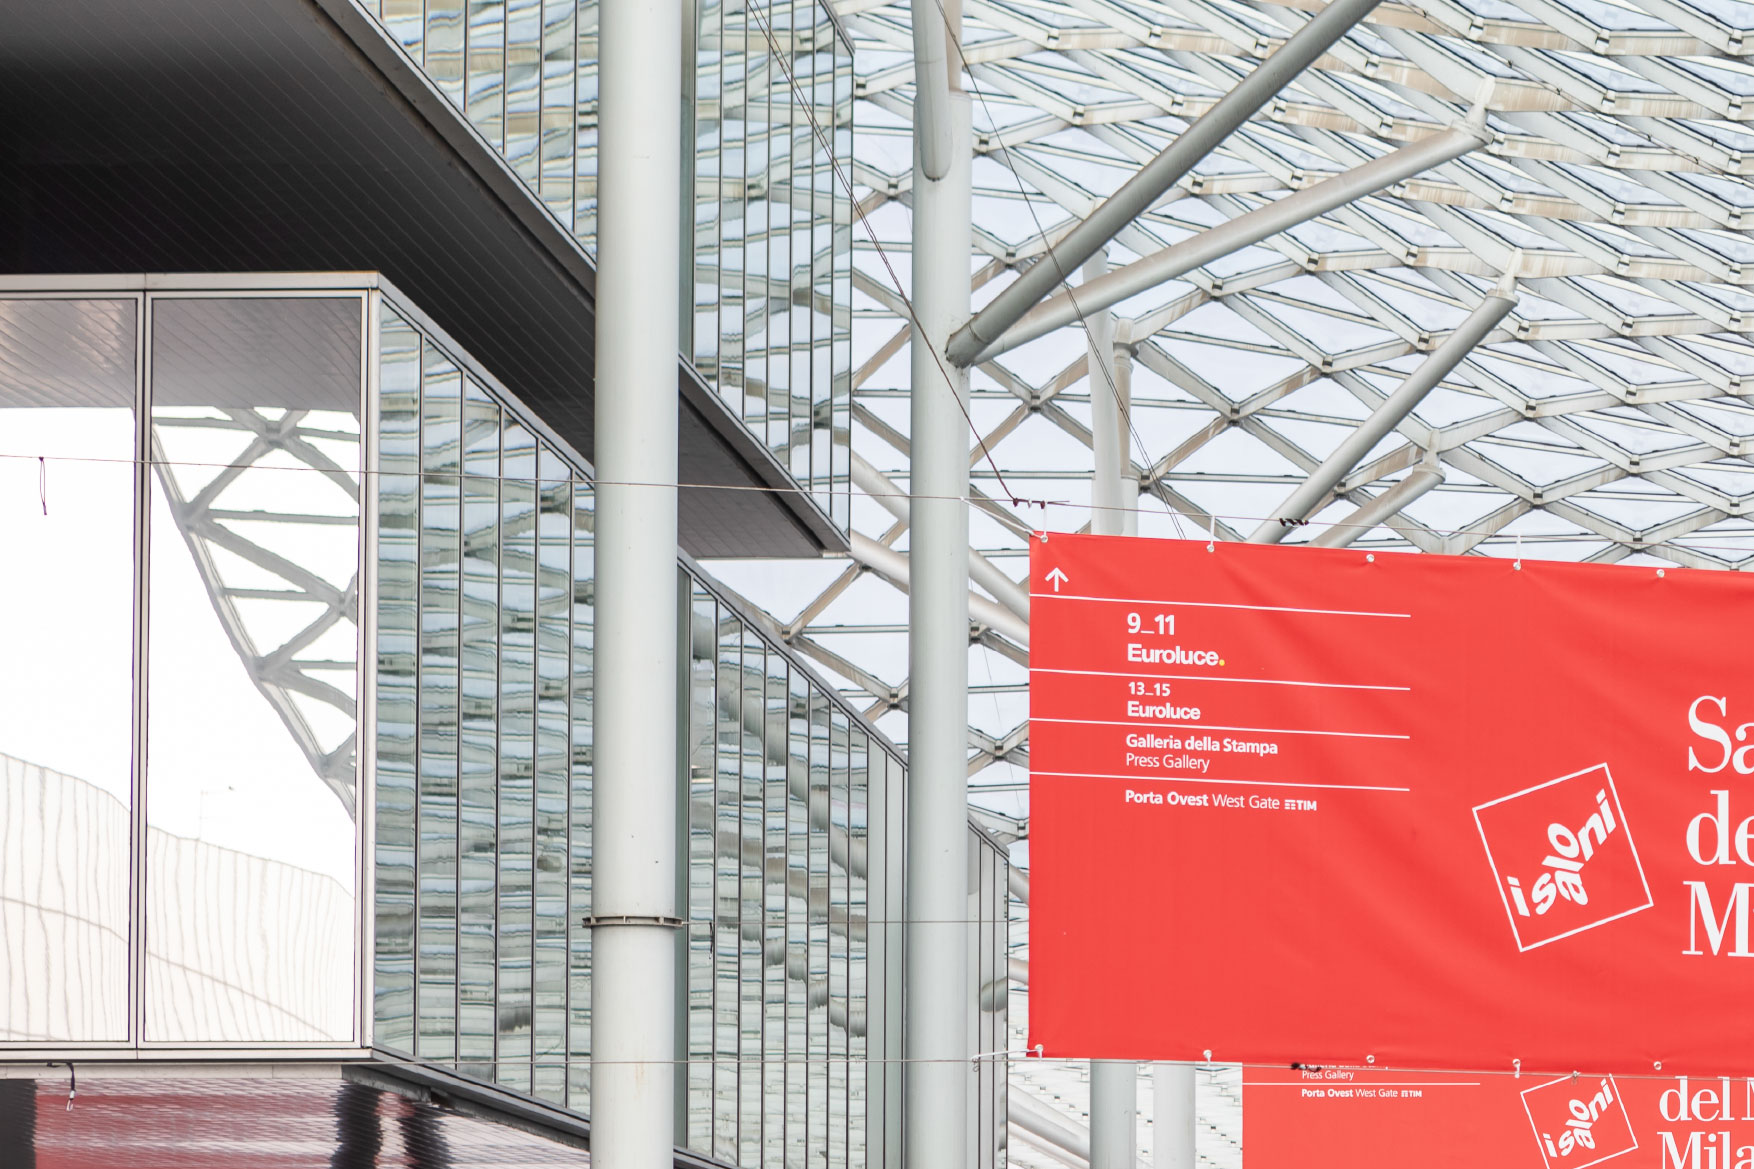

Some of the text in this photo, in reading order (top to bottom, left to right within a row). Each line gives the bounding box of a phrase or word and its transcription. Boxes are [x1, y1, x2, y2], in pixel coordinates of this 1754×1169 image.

[1128, 613, 1174, 635] 9_11
[1128, 644, 1225, 666] Euroluce.
[1129, 682, 1170, 696] 13_15
[1128, 701, 1200, 719] Euroluce
[1126, 734, 1277, 756] Galleria della Stampa
[1127, 753, 1210, 773] Press Gallery
[1126, 790, 1316, 810] Porta Ovest West Gate TIM
[1302, 1070, 1354, 1081] Press Gallery
[1302, 1089, 1325, 1097] Porta
[1328, 1089, 1353, 1097] Ovest
[1355, 1089, 1376, 1097] West
[1378, 1089, 1398, 1097] Gate
[1660, 1076, 1734, 1121] del
